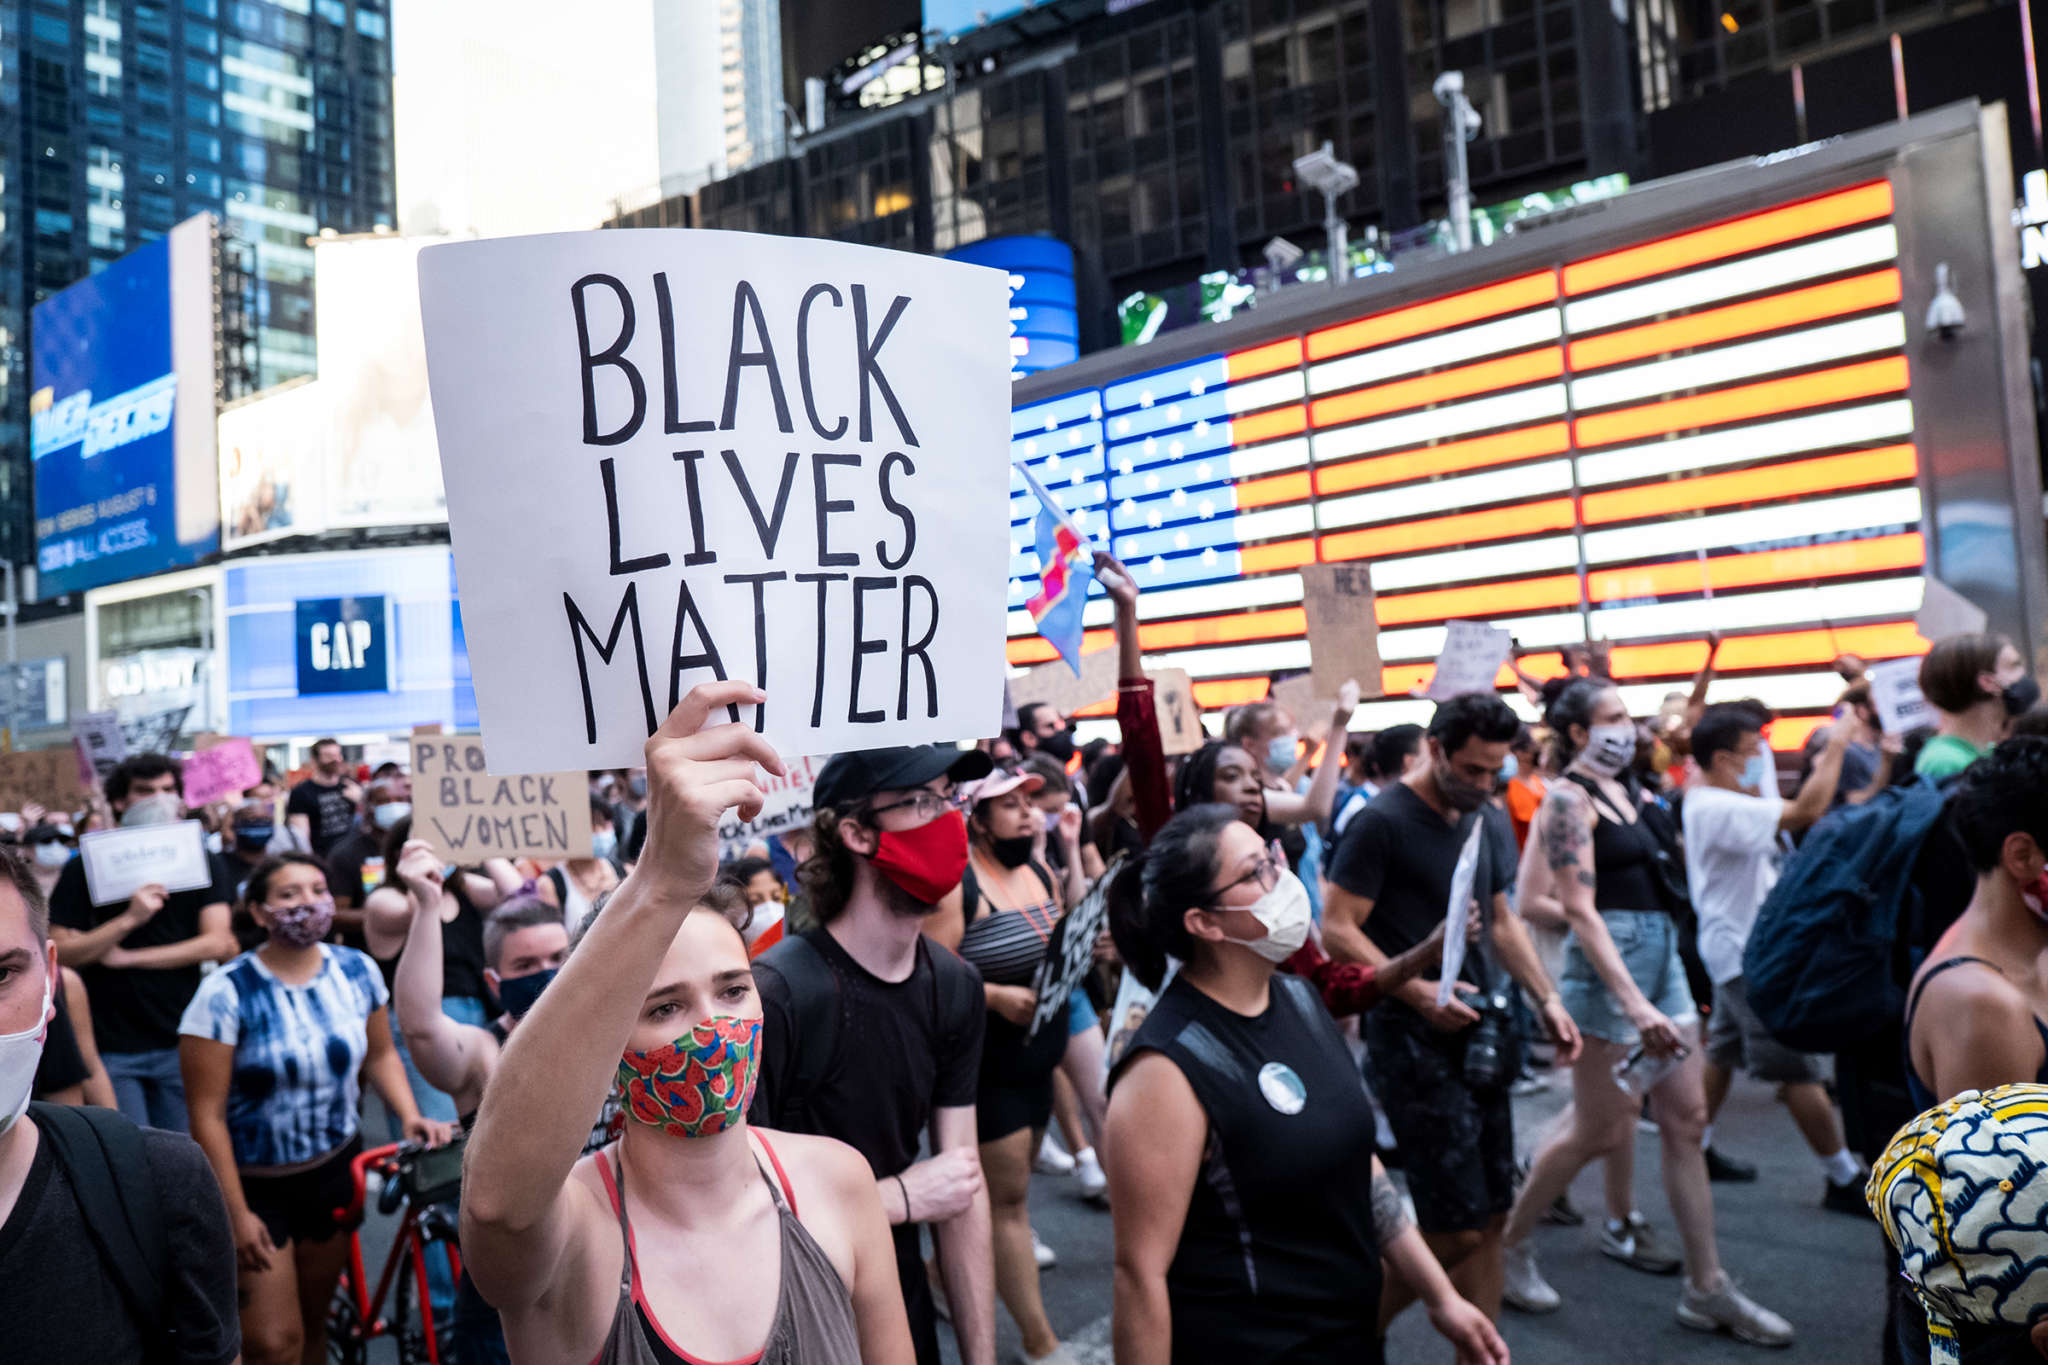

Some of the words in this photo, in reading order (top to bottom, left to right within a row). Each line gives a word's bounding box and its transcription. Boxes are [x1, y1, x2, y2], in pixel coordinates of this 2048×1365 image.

[571, 272, 920, 448] BLACK
[600, 450, 916, 575] LIVES
[310, 619, 372, 672] GAP
[563, 571, 940, 745] MATTER
[431, 810, 569, 851] WOMEN
[440, 774, 559, 807] BLACK
